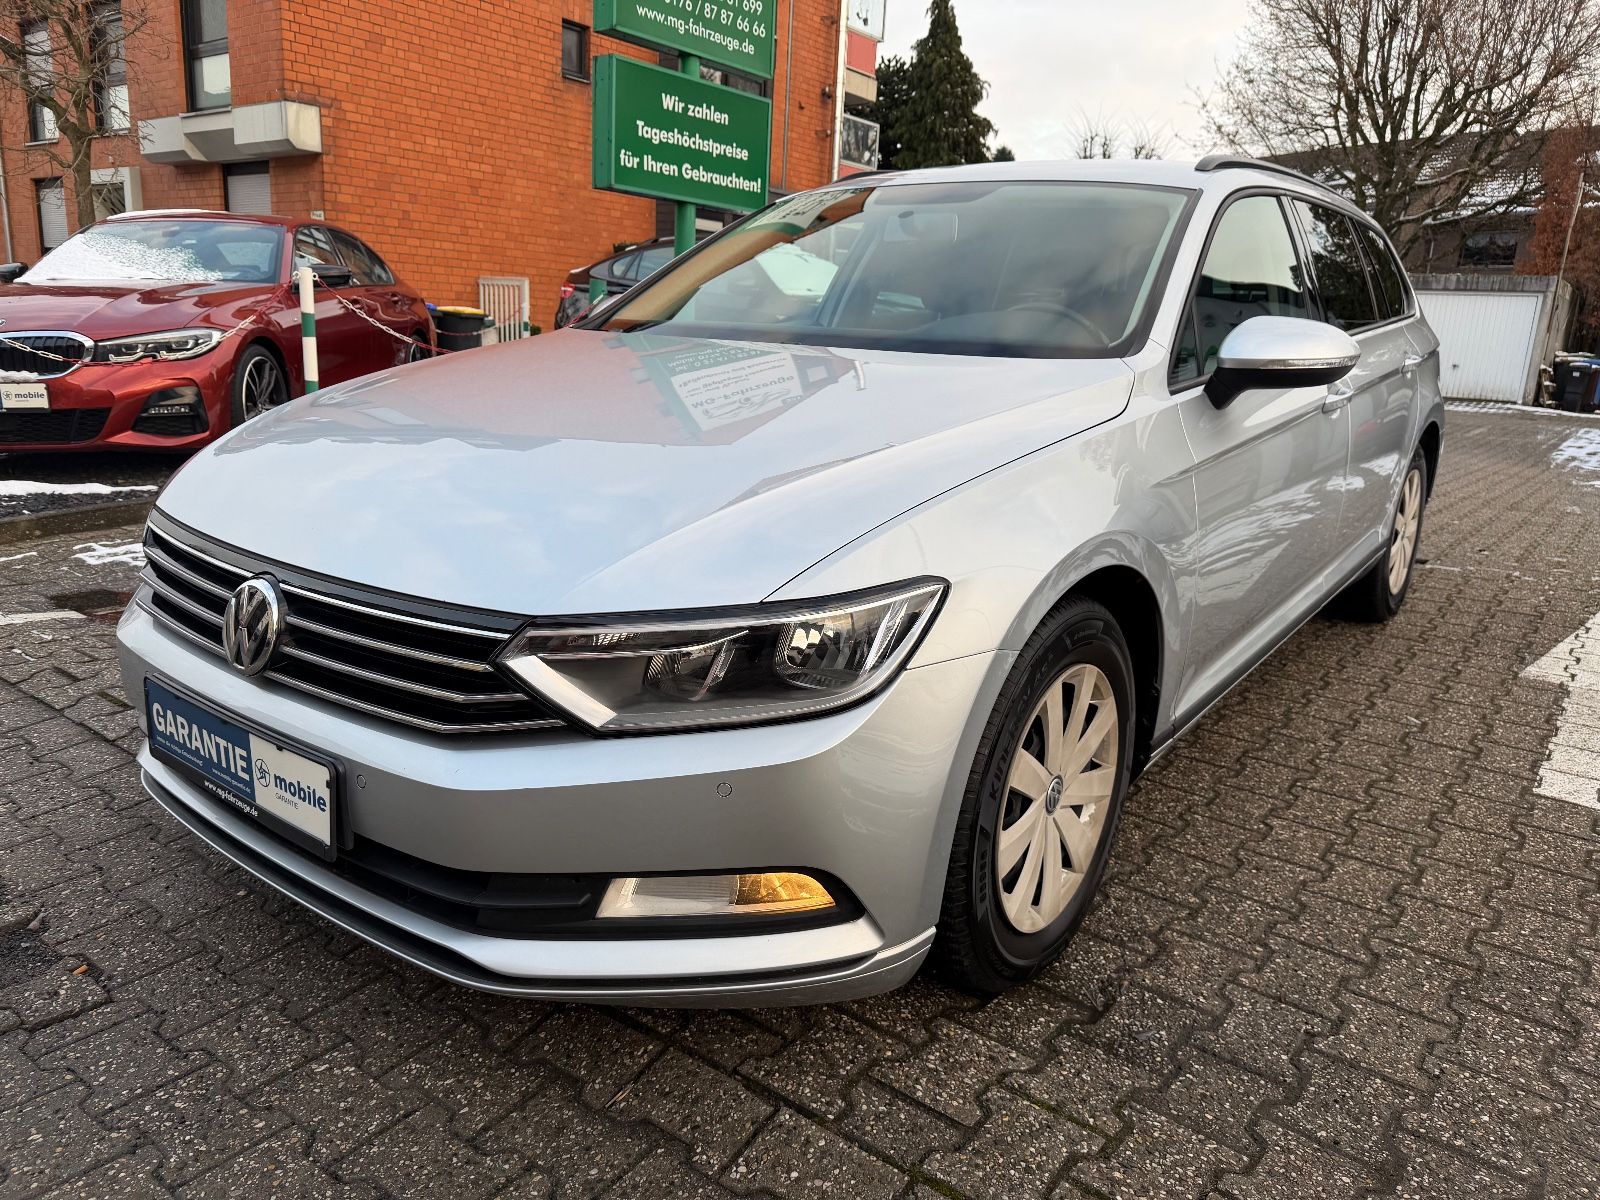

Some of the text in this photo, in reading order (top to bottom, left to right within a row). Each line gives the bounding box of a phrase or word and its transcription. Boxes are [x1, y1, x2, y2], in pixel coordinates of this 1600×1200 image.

[704, 2, 717, 20] 87
[720, 9, 734, 26] 87
[736, 15, 750, 32] 66
[752, 21, 766, 38] 66
[743, 0, 762, 15] 699
[636, 4, 755, 54] www.mg-fahrzeuge.de
[661, 93, 729, 125] Wir zahlen
[636, 120, 749, 161] Tageshöchstpreise
[619, 149, 762, 193] für Ihren Gebrauchten!
[14, 391, 45, 399] mobile
[152, 702, 250, 782] GARANTIE
[273, 771, 327, 813] mobile
